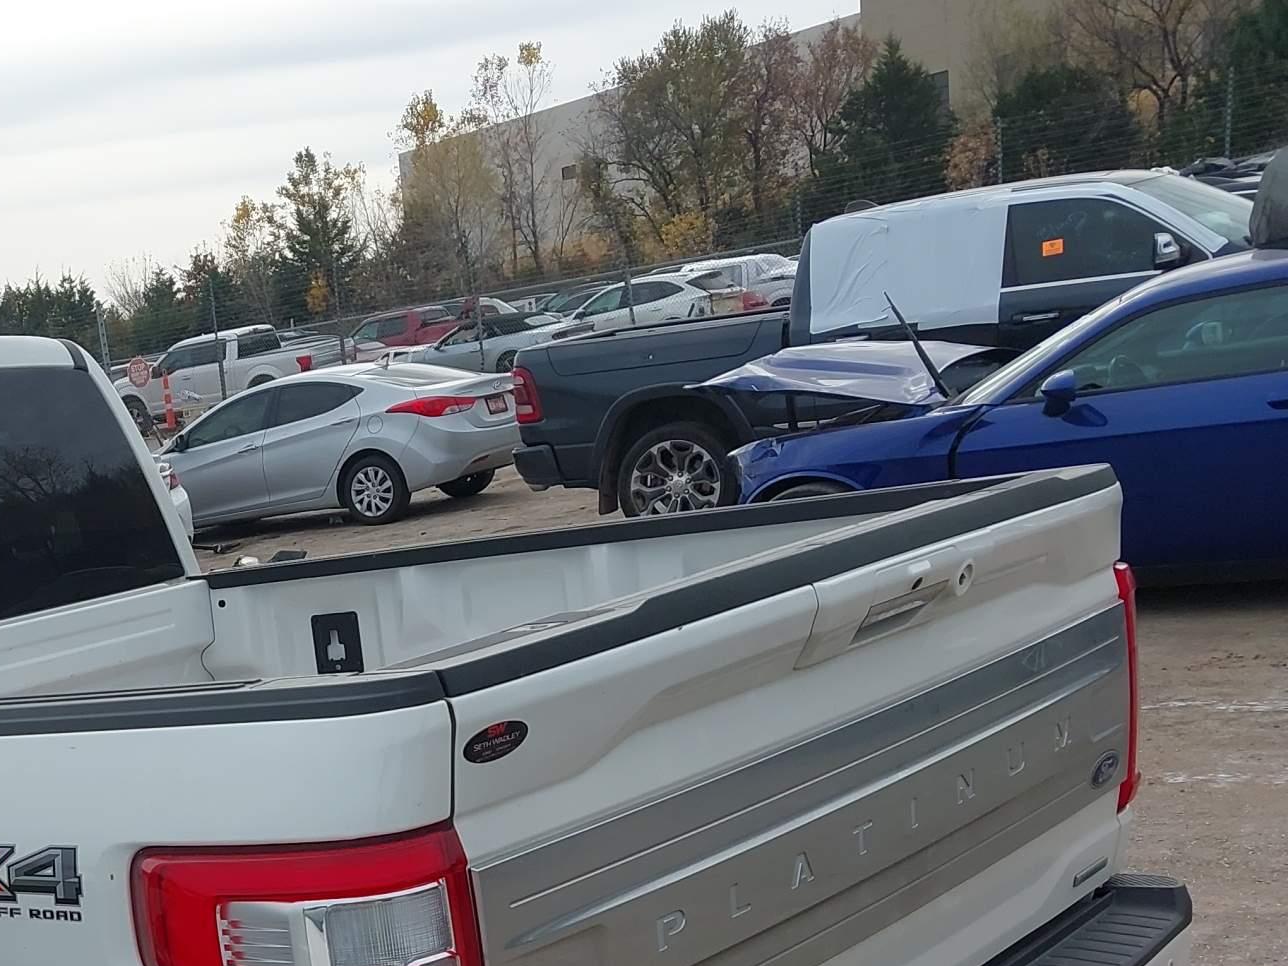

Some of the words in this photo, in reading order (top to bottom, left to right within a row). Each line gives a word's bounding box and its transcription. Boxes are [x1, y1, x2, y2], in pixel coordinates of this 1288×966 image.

[130, 362, 146, 372] STOP
[473, 740, 492, 752] SETH
[656, 715, 1073, 952] PLATINUM
[28, 908, 83, 922] ROAD
